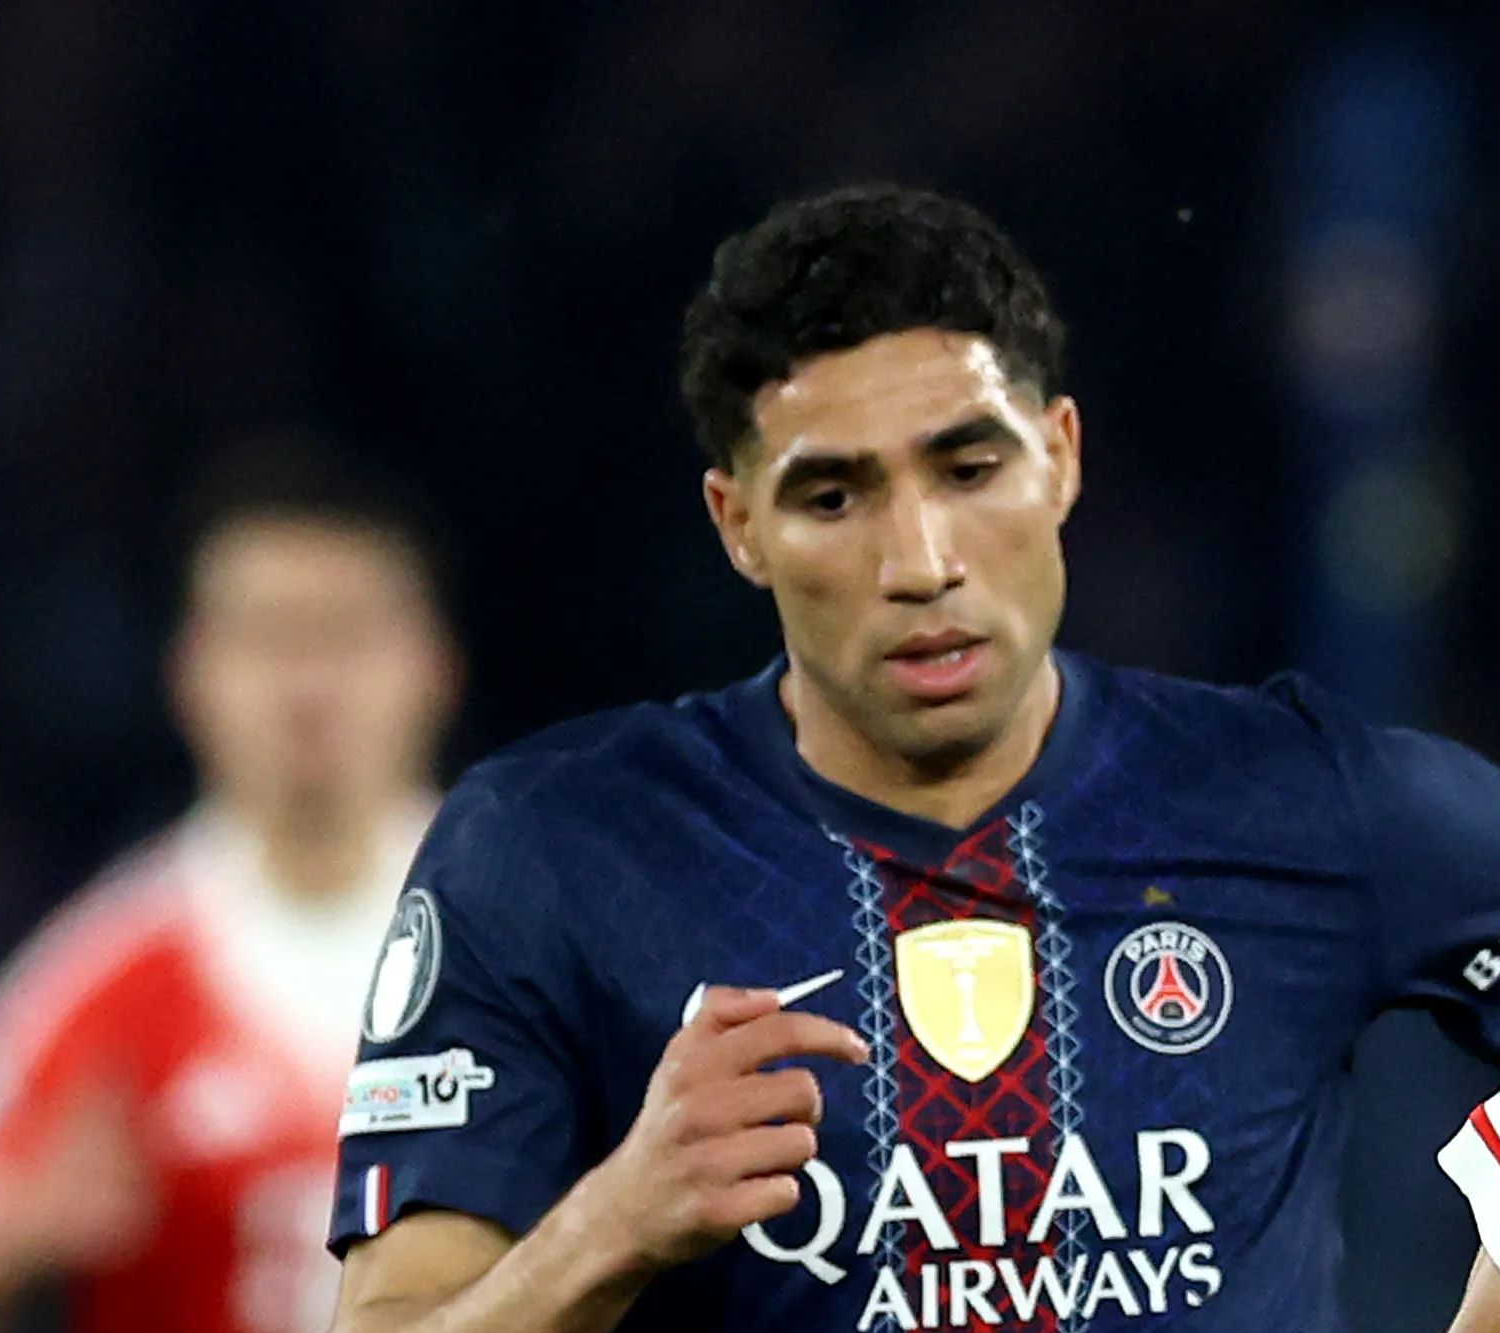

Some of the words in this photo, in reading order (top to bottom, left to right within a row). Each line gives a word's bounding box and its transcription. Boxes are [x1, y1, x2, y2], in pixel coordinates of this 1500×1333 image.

[1123, 929, 1207, 962] PARIS
[416, 1073, 459, 1106] 10
[741, 1127, 1216, 1285] QATAR
[856, 1241, 1222, 1332] AIRWAYS
